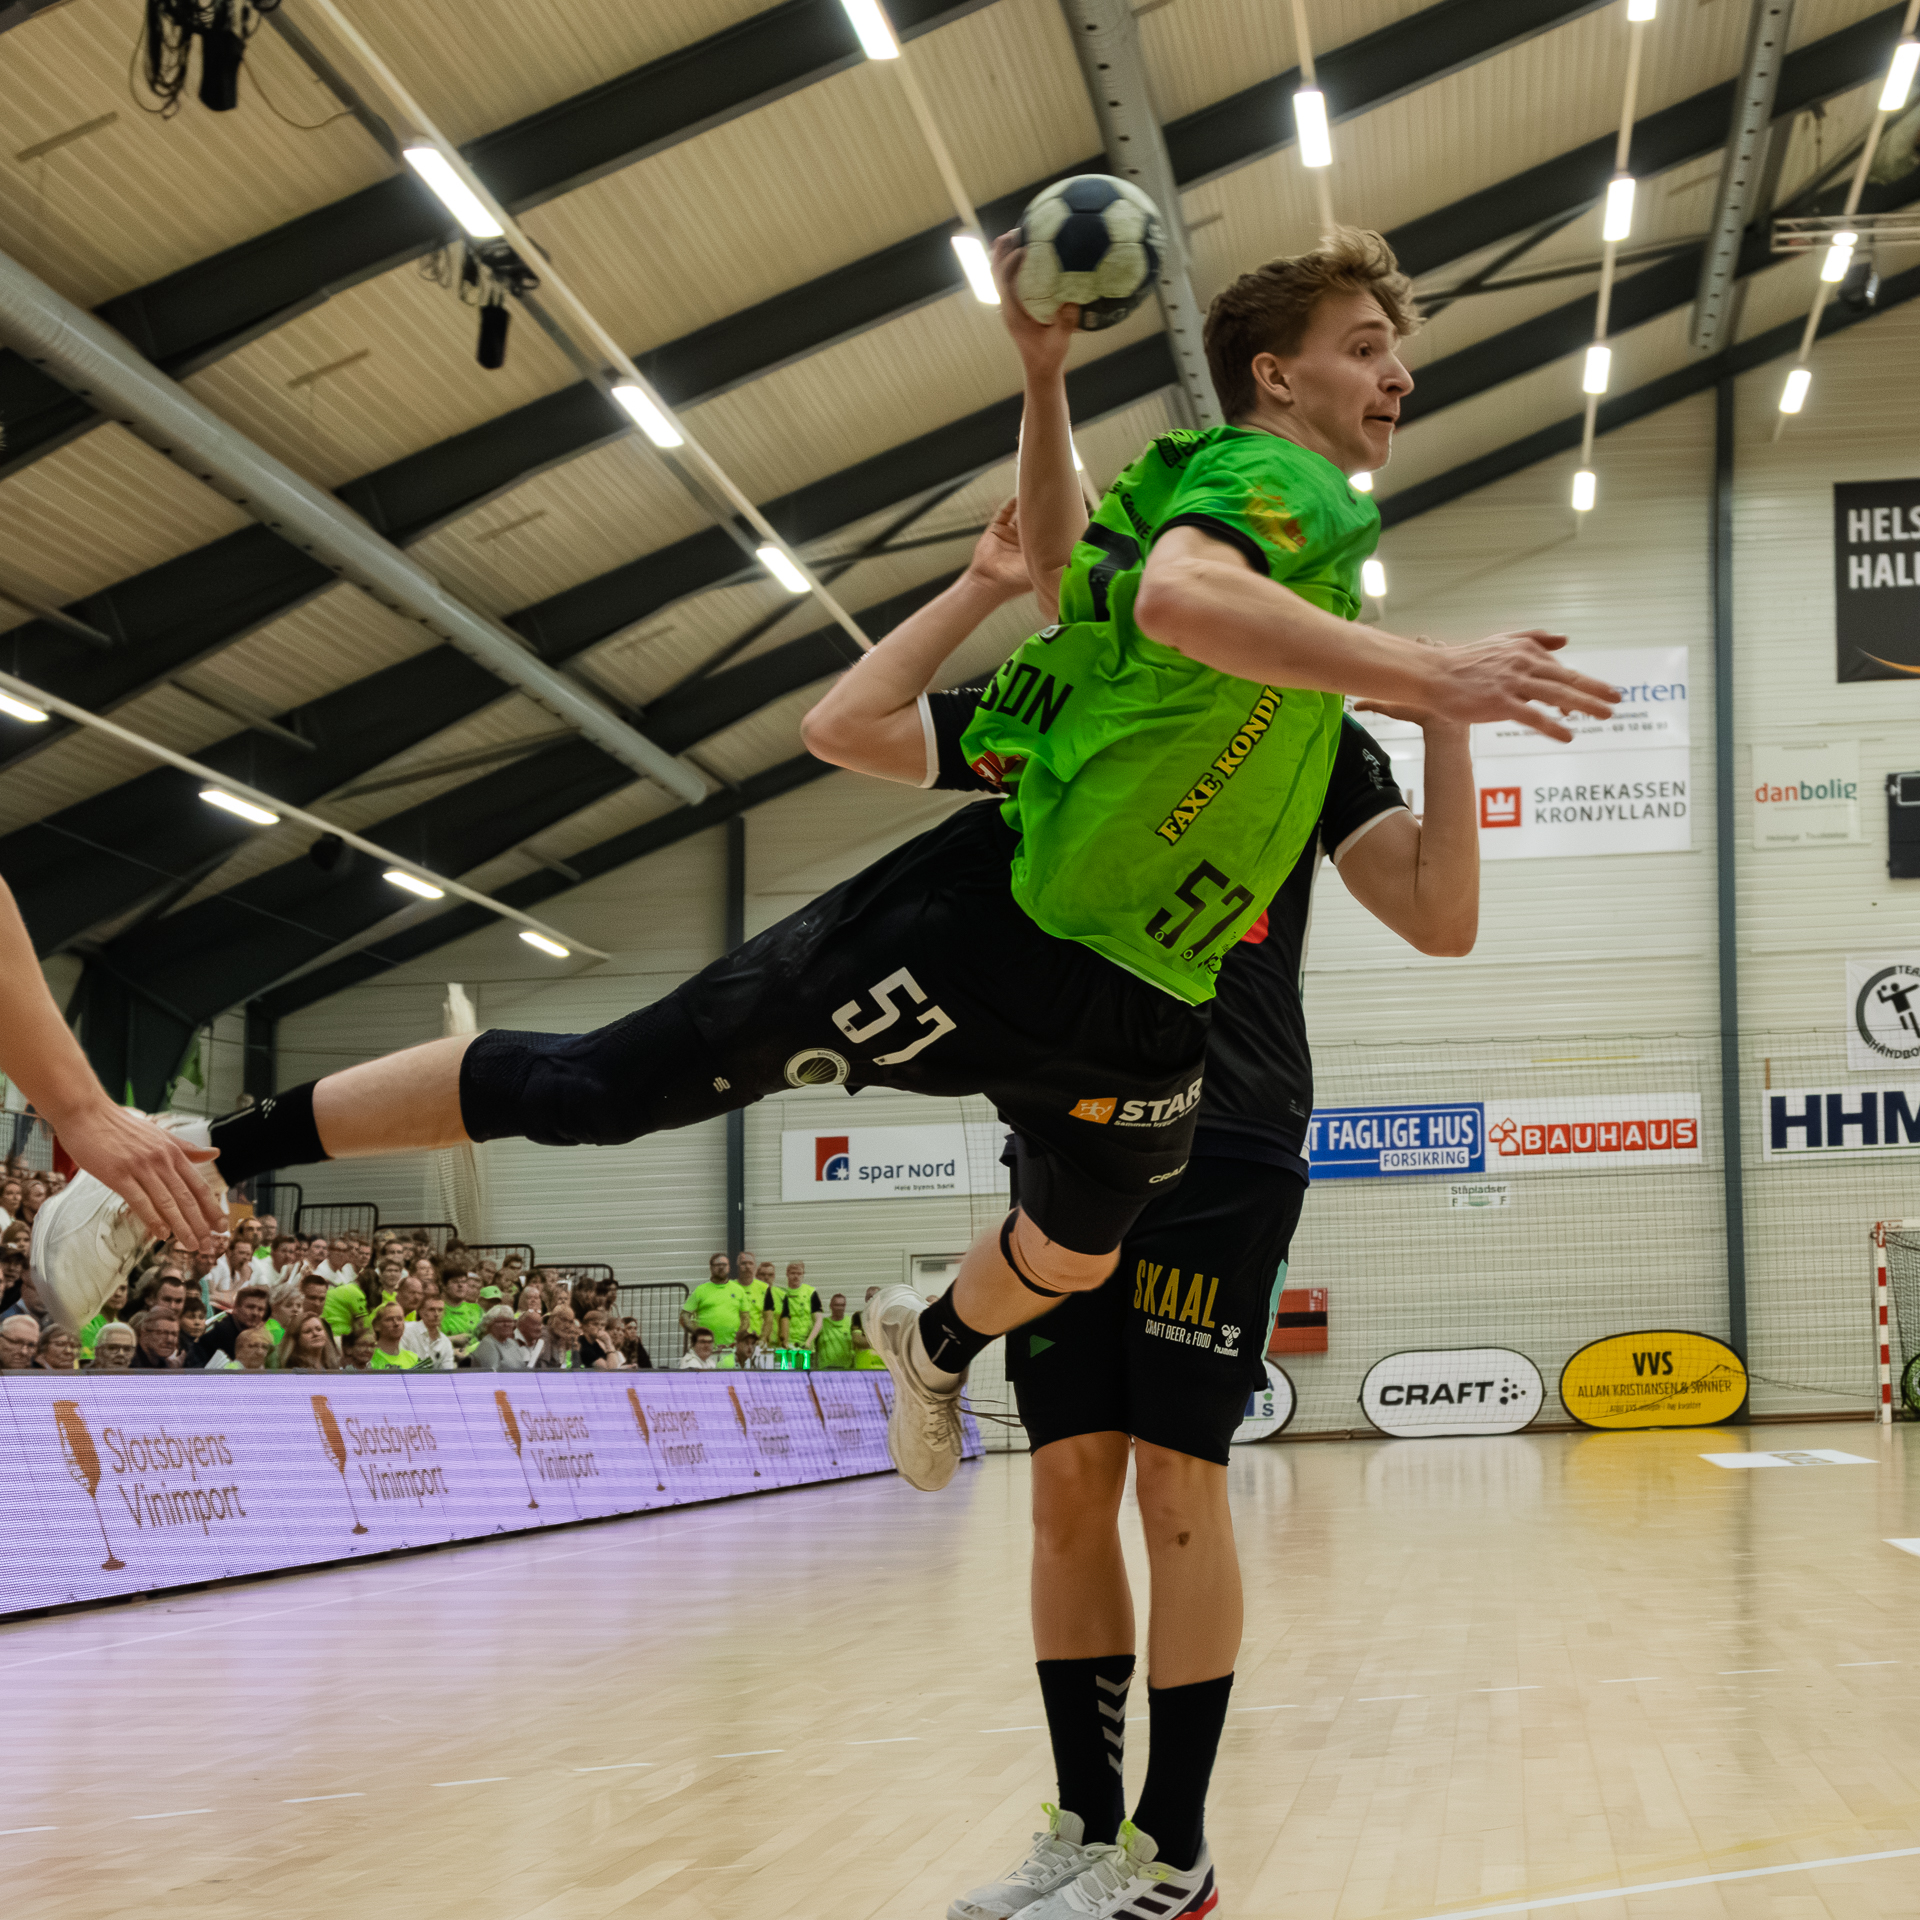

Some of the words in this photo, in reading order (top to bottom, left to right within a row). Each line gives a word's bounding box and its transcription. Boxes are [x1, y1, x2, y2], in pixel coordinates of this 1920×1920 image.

[1155, 772, 1223, 846] FAXE
[1211, 685, 1283, 779] KONDI
[1534, 780, 1686, 803] SPAREKASSEN
[1755, 778, 1857, 801] danbolig
[1535, 802, 1687, 824] KRONJYLLAND
[1145, 859, 1255, 961] 57
[832, 966, 957, 1066] 57
[1328, 1117, 1421, 1151] FAGLIGE
[1428, 1114, 1474, 1146] HUS
[1523, 1120, 1696, 1153] BAUHAUS
[859, 1164, 904, 1183] spar
[1383, 1151, 1466, 1168] FORSIKRING
[1133, 1259, 1219, 1329] SKAAL
[1145, 1319, 1166, 1338] CRAFT
[1165, 1325, 1186, 1343] BEER
[1192, 1331, 1212, 1348] FOOD
[1632, 1351, 1673, 1376] VVS
[1379, 1381, 1494, 1407] CRAFT
[1578, 1384, 1610, 1398] ALLAN
[1613, 1382, 1678, 1397] KRISTIANSEN
[103, 1426, 233, 1481] Slotsbyens
[345, 1415, 438, 1463] Slotsbyens
[359, 1463, 448, 1508] Vinimport
[118, 1481, 246, 1535] Vinimport
